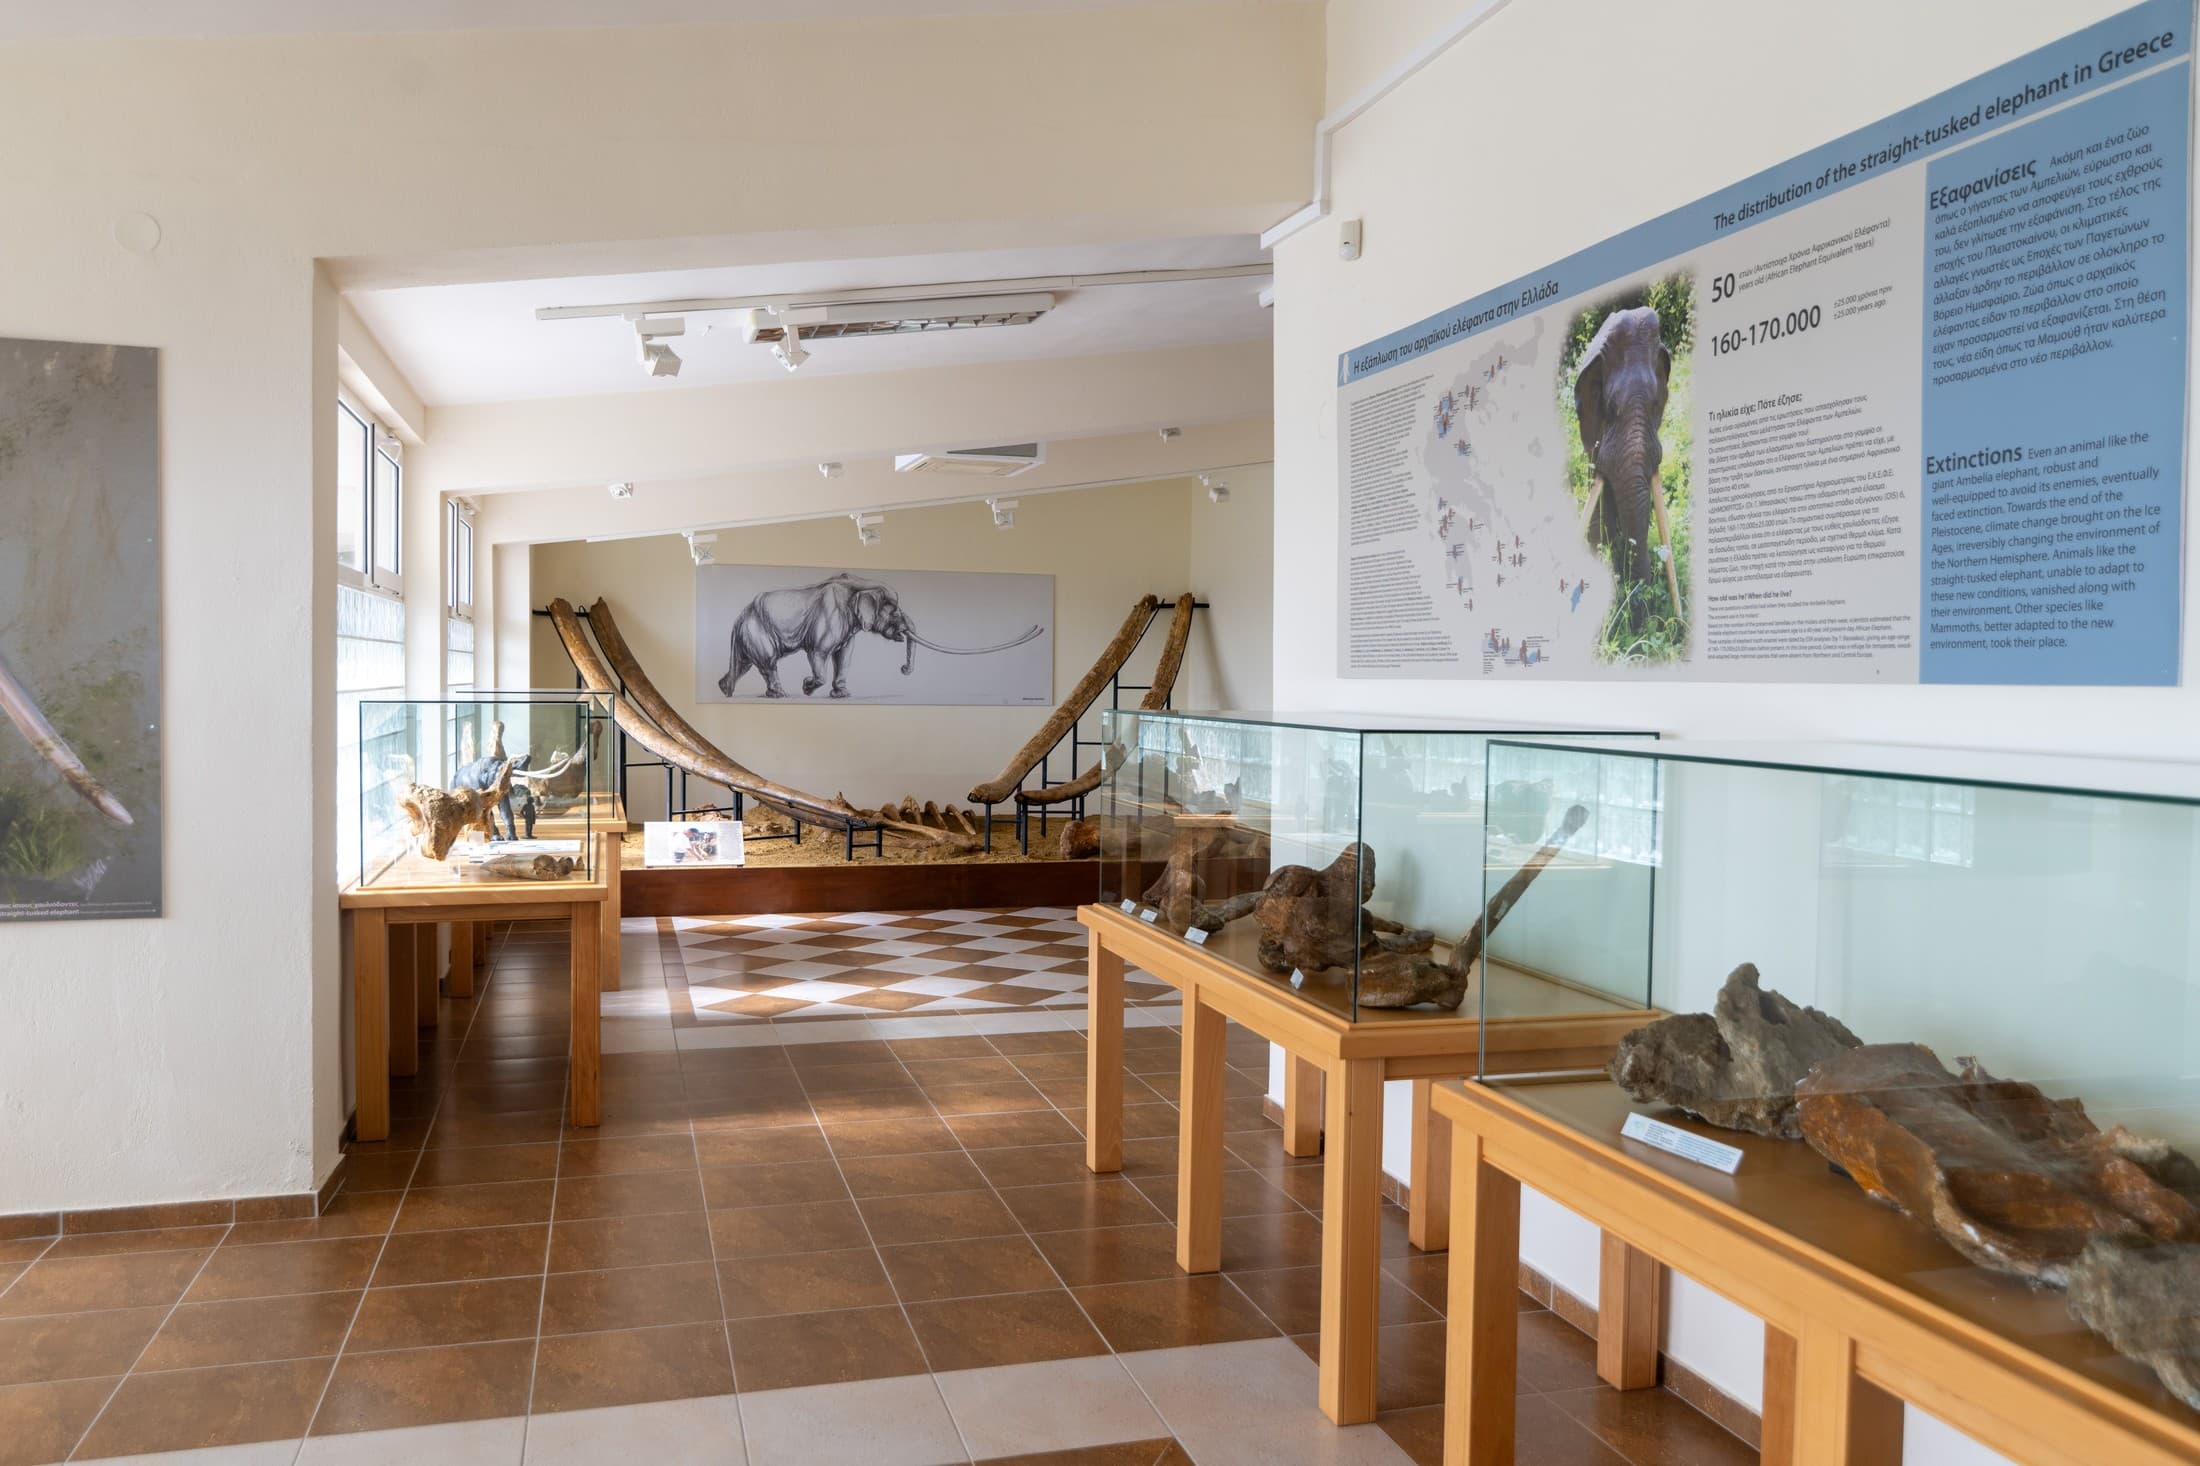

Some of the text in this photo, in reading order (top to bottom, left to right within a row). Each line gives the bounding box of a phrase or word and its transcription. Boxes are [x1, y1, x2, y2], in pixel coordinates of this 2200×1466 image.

[1713, 31, 2173, 230] The distribution of the straight-tusked elephant in Greece
[2085, 142, 2102, 155] και
[1929, 159, 2036, 210] Εξαφανίσεις
[1959, 207, 1966, 216] ο
[2009, 185, 2028, 199] των
[2134, 143, 2152, 156] και
[2017, 201, 2030, 213] να
[2087, 173, 2113, 190] τους
[1953, 238, 1969, 251] δεν
[2008, 220, 2026, 233] την
[2086, 194, 2106, 208] Στο
[2143, 177, 2161, 191] της
[2059, 223, 2070, 235] οι
[2003, 275, 2015, 285] το
[2077, 253, 2091, 265] σε
[2151, 233, 2165, 245] το
[2062, 237, 2084, 251] των
[1711, 272, 1736, 304] 50
[2075, 273, 2084, 284] ο
[2008, 307, 2020, 318] το
[2083, 286, 2104, 299] στο
[2026, 320, 2039, 331] να
[2114, 297, 2134, 310] Στη
[1353, 279, 1558, 375] Η εξάπλωση του αρχαϊκού ελέφαντα στην Ελλάδα
[1711, 304, 1822, 357] 160-170.000
[2023, 338, 2035, 349] τα
[2009, 357, 2028, 369] στο
[1926, 446, 2022, 475] Extinctions
[2027, 431, 2149, 460] Even an animal like the
[1931, 455, 2098, 493] giant Ambelia elephant, robust and
[1931, 465, 2159, 505] well-equipped to avoid its enemies, eventually
[1931, 489, 2123, 522] faced extinction. Towards the end of the
[1931, 503, 2160, 537] Pleistocene, climate change brought on the Ice
[1931, 520, 2160, 556] Ages, irreversibly changing the environment of
[1931, 543, 2136, 570] the Northern Hemisphere. Animals like the
[1930, 561, 2144, 587] straight-tusked elephant, unable to adapt to
[1930, 578, 2135, 601] these new conditions, vanished along with
[1930, 599, 2104, 617] their environment. Other species like
[1930, 617, 2114, 633] Mammoths, better adapted to the new
[1929, 635, 2067, 650] environment, took their place.
